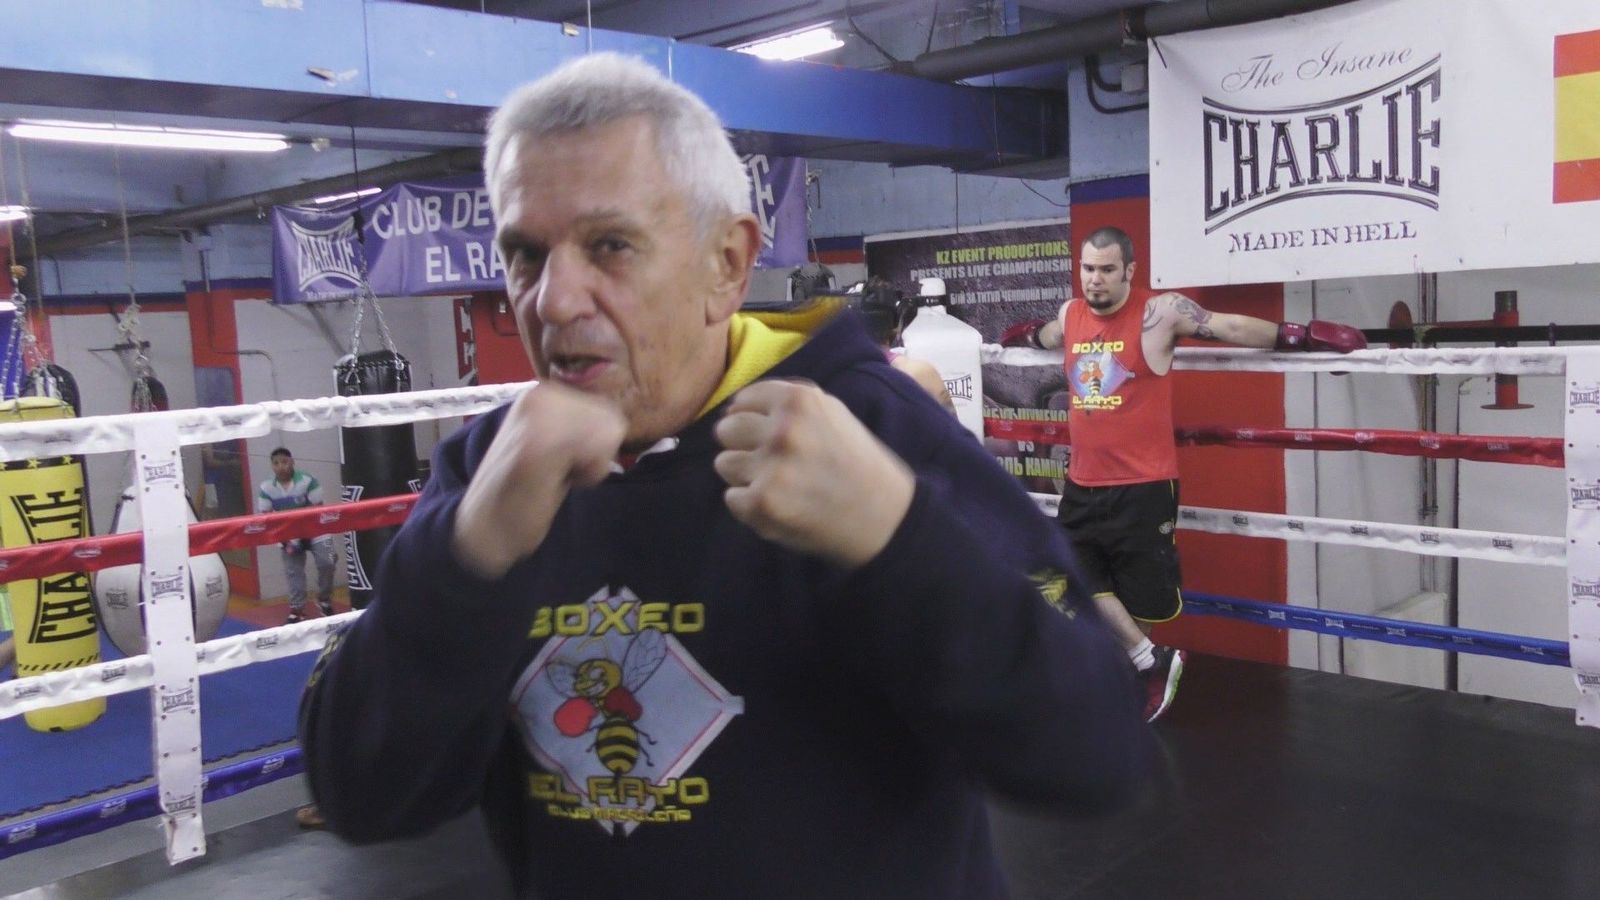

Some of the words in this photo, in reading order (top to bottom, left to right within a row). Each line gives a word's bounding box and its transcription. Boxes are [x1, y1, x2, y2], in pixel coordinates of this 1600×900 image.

[1221, 54, 1284, 93] The
[1297, 40, 1412, 81] Insane
[1203, 68, 1441, 222] CHARLIE
[372, 195, 442, 240] CLUB
[1228, 231, 1305, 253] MADE
[1311, 226, 1339, 246] IN
[1344, 220, 1418, 244] HELL
[426, 245, 461, 283] EL
[466, 240, 508, 280] RA
[910, 264, 966, 281] PRESENTS
[967, 263, 992, 278] LIVE
[993, 257, 1072, 276] CHAMPIONSHI
[952, 247, 986, 264] EVENT
[946, 376, 972, 399] RLIE
[15, 486, 98, 644] CHALIE
[529, 772, 581, 804] EL
[587, 776, 710, 805] RAYO
